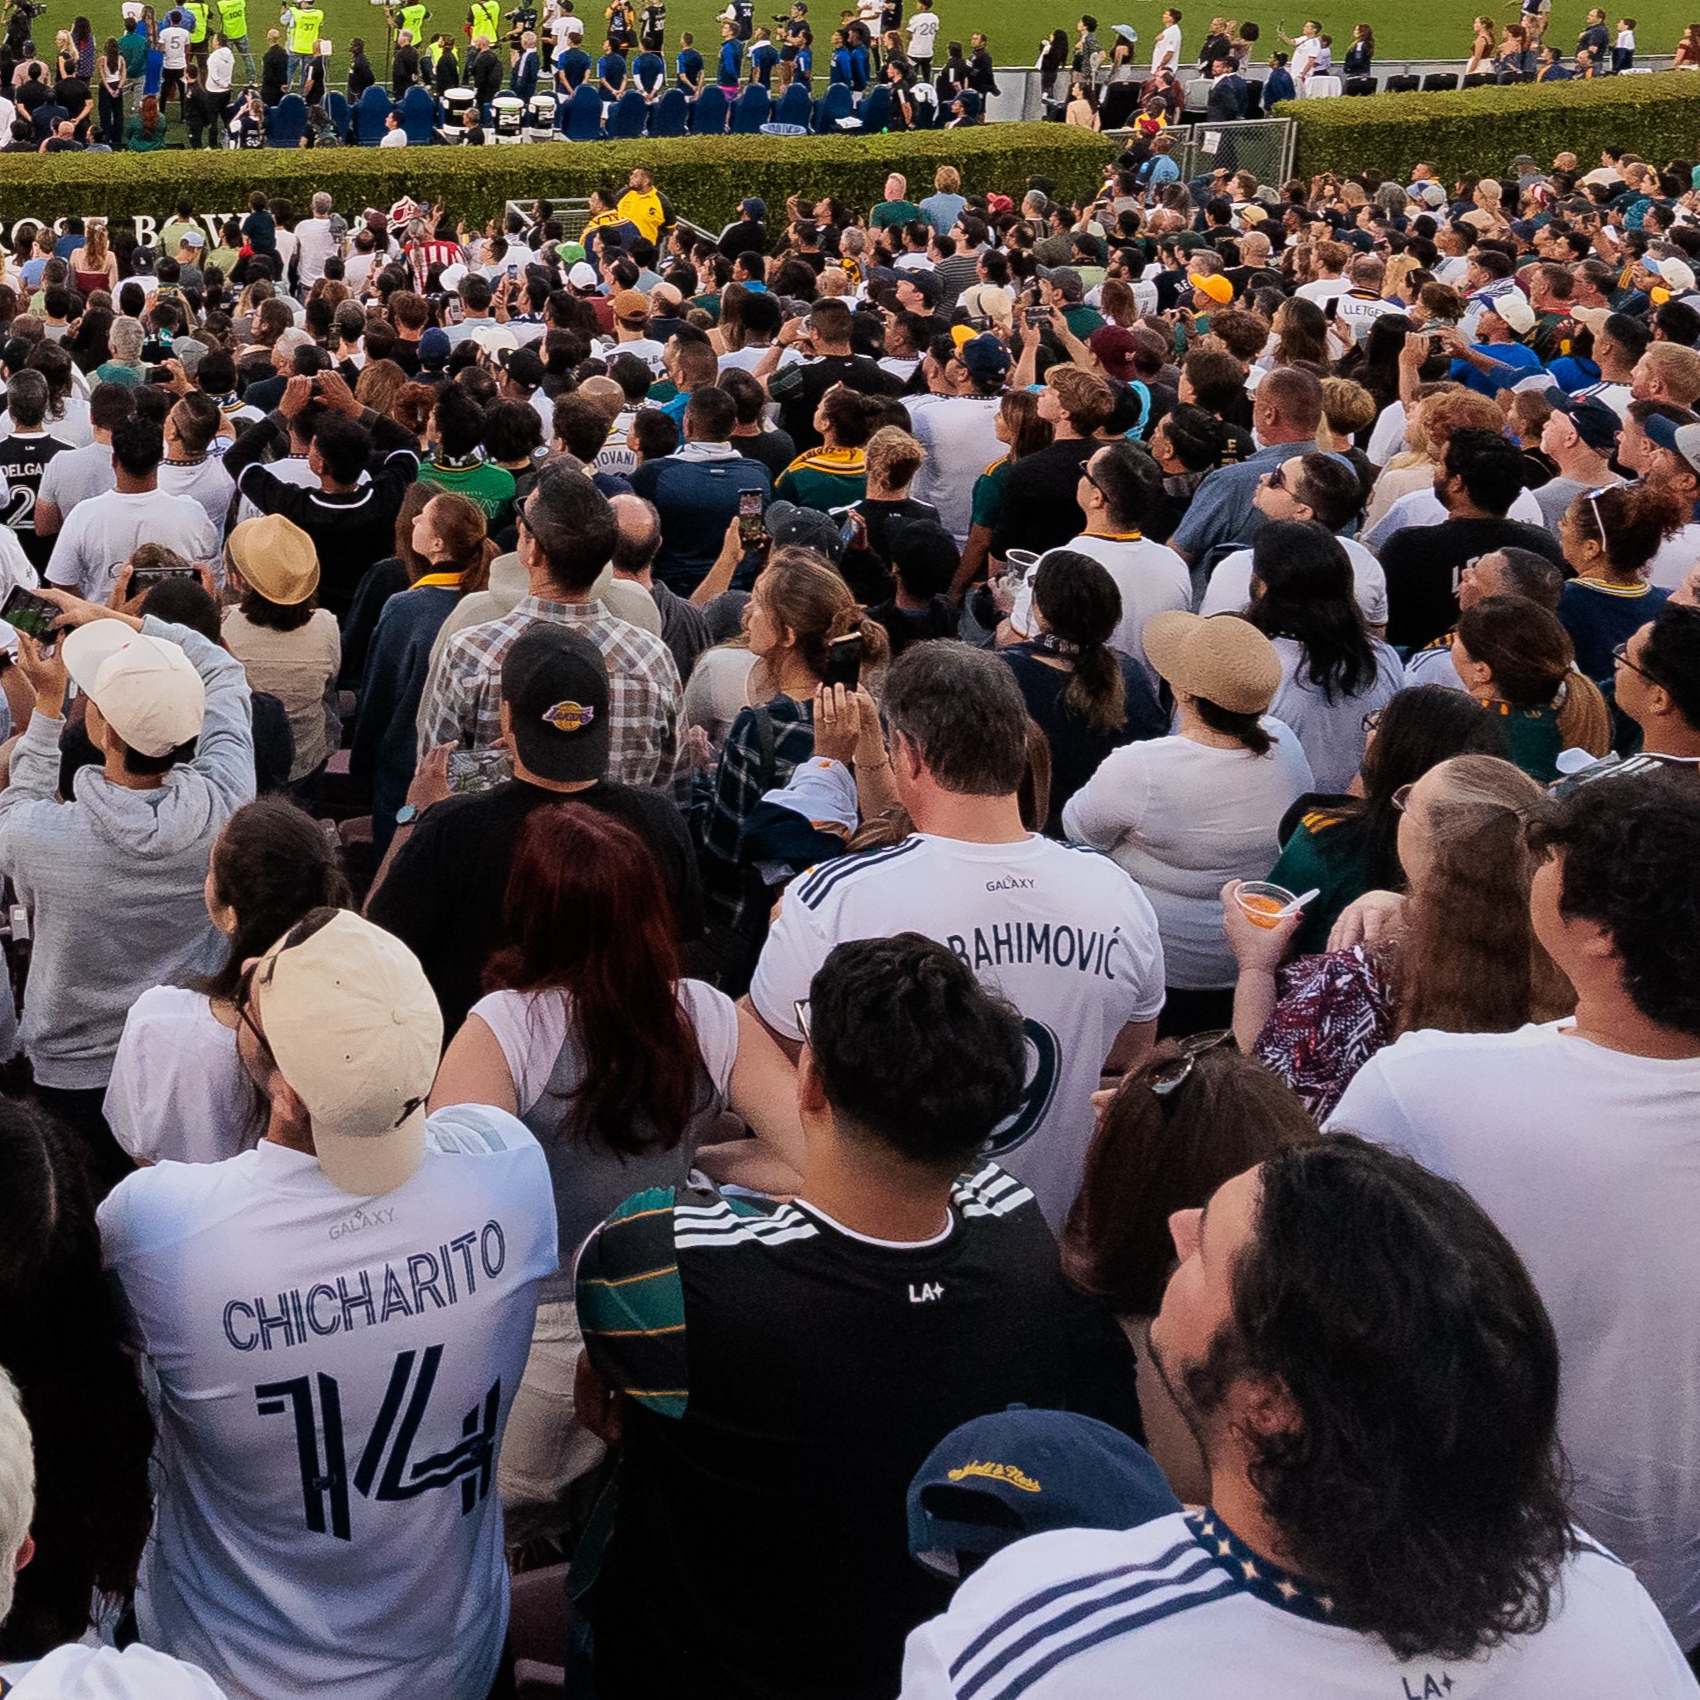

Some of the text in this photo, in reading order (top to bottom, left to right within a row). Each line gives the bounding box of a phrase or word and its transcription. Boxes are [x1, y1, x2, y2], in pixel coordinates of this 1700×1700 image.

[303, 23, 314, 31] 37
[919, 22, 937, 36] 28
[170, 36, 180, 49] 5
[986, 878, 1035, 892] GALAXY
[946, 921, 1121, 981] RAHIMOVIĆ
[329, 1208, 396, 1241] GALAXY
[223, 1219, 505, 1351] CHICHARITO
[908, 1283, 935, 1302] LA
[255, 1343, 501, 1542] 14
[1402, 1673, 1443, 1700] LA
